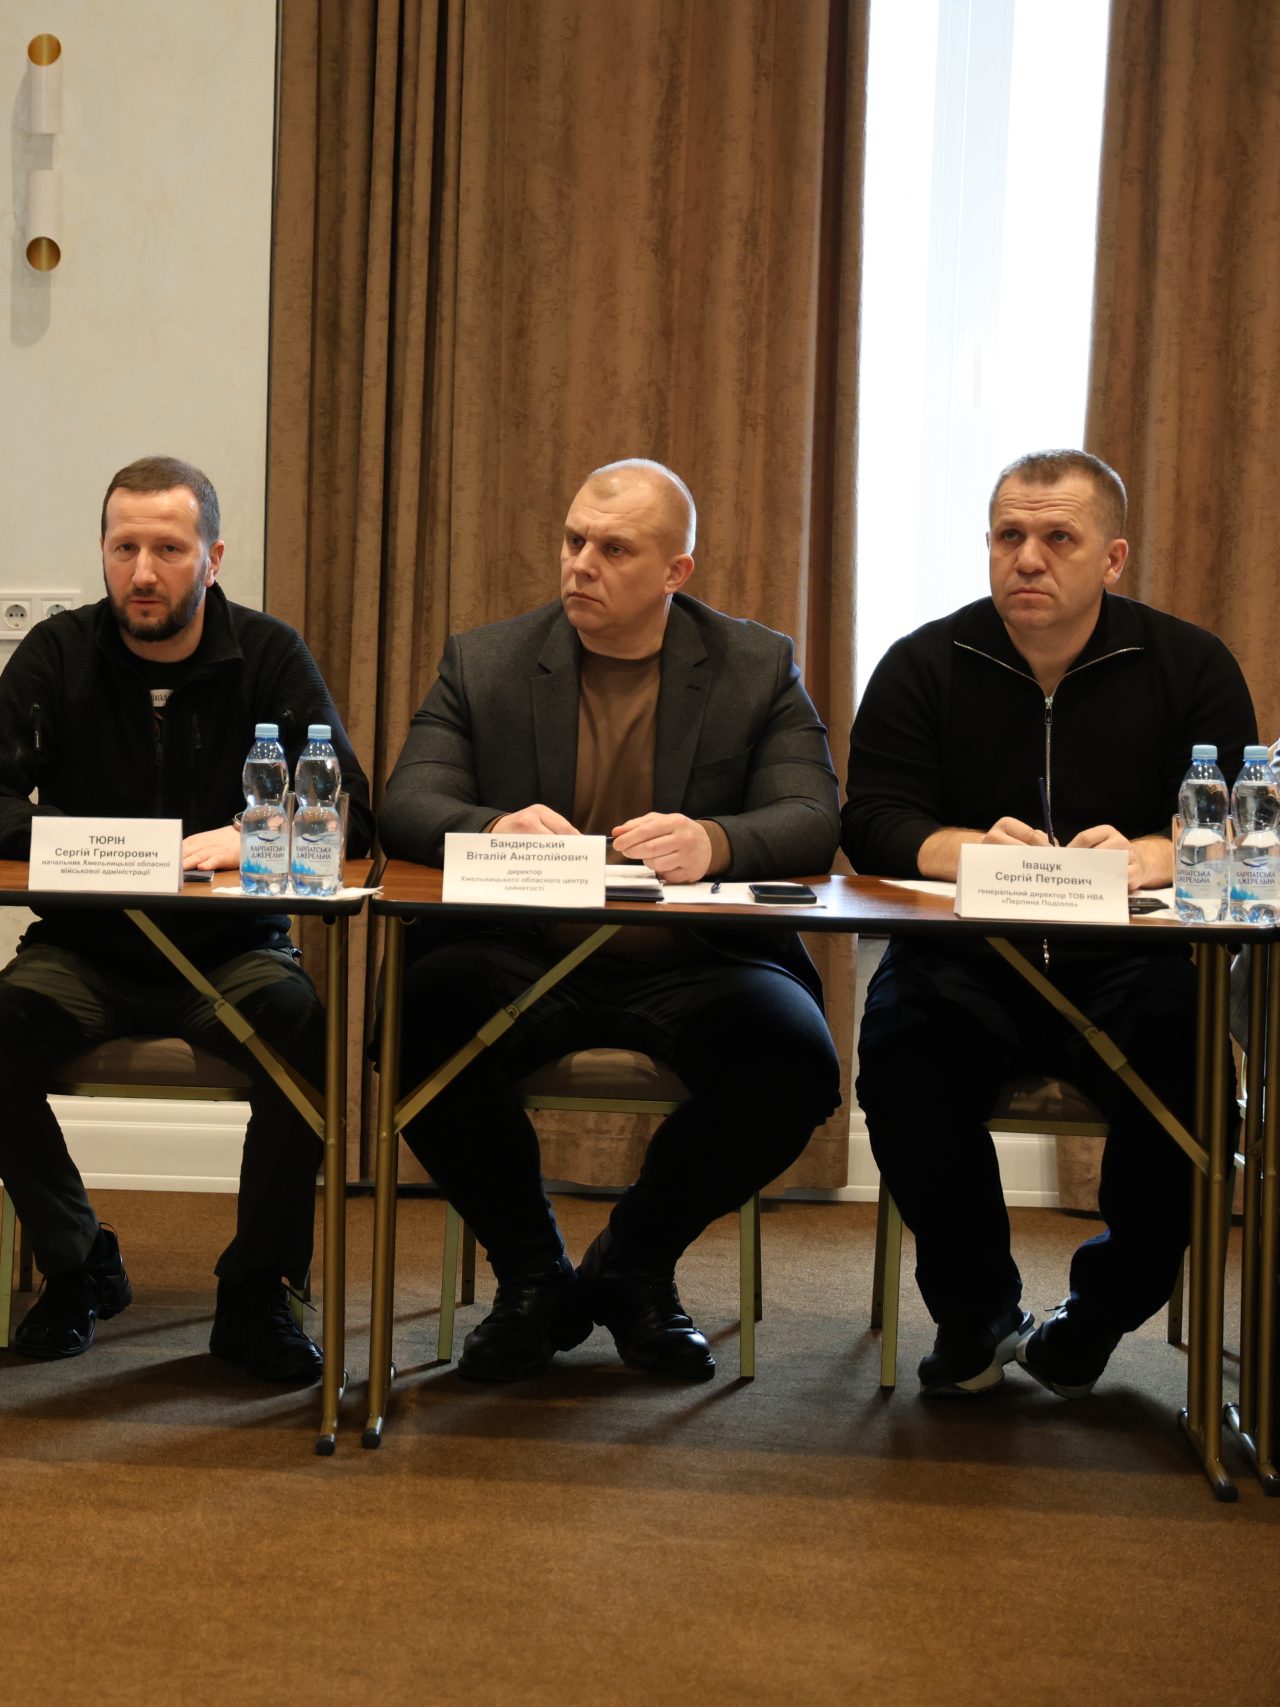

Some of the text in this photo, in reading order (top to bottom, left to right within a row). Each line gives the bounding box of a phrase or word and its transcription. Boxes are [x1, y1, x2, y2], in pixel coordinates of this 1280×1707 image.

[89, 836, 125, 845] ТЮРІН
[490, 839, 565, 850] Бандирський
[55, 848, 158, 859] Сергій Григорович
[466, 851, 588, 861] Віталій Анатолійович
[1022, 860, 1062, 871] Іващук
[995, 872, 1092, 885] Сергій Петрович
[977, 889, 1104, 901] генеральний директор ТОВ НВА
